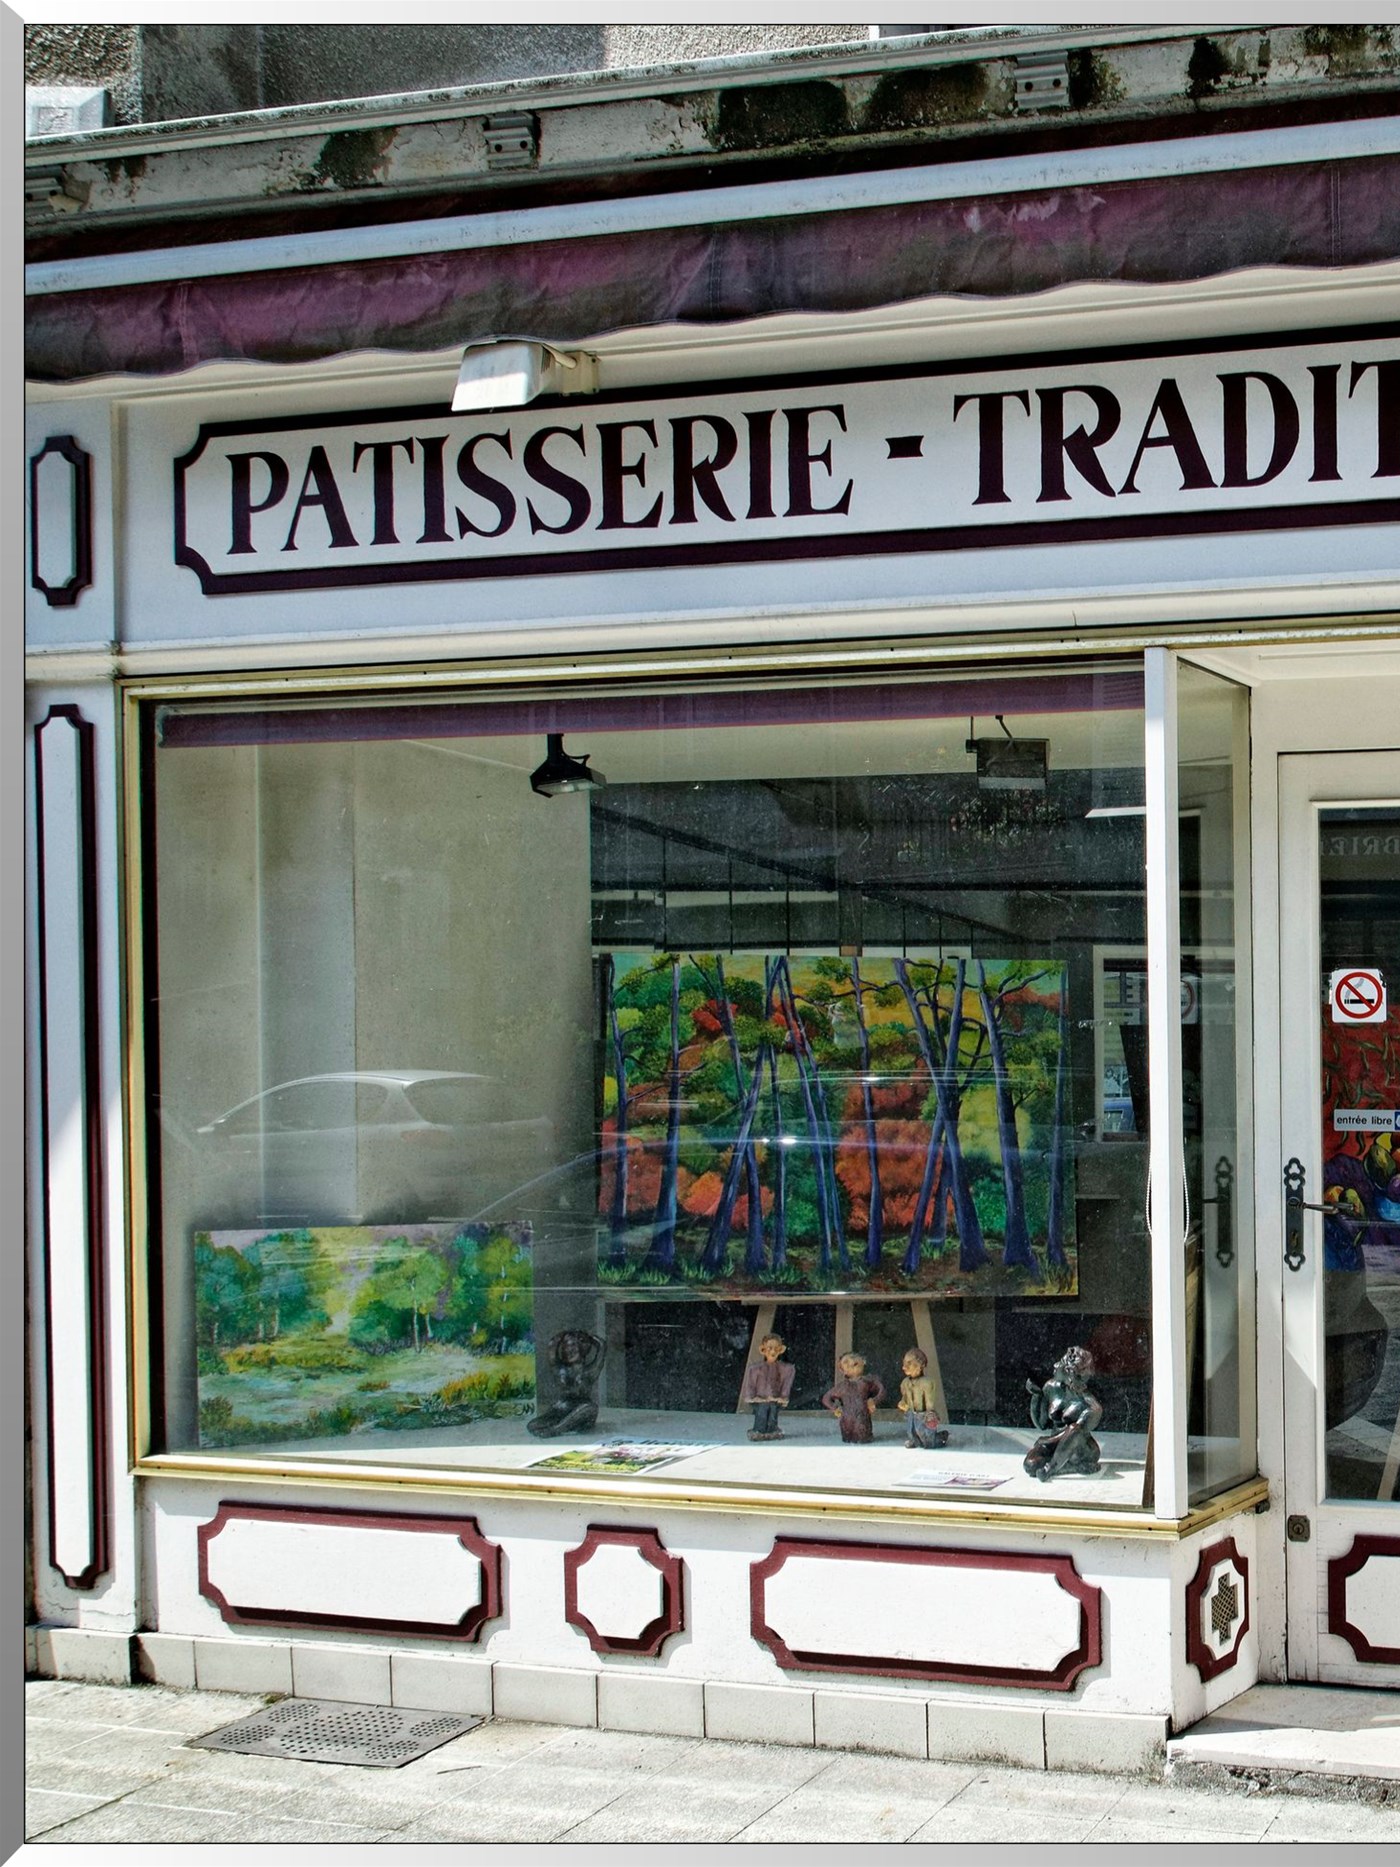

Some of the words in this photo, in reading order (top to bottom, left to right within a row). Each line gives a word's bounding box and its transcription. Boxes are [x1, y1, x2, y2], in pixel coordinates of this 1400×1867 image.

[224, 403, 854, 556] PATISSERIE
[1336, 1114, 1368, 1125] entrée
[1371, 1115, 1393, 1126] libre
